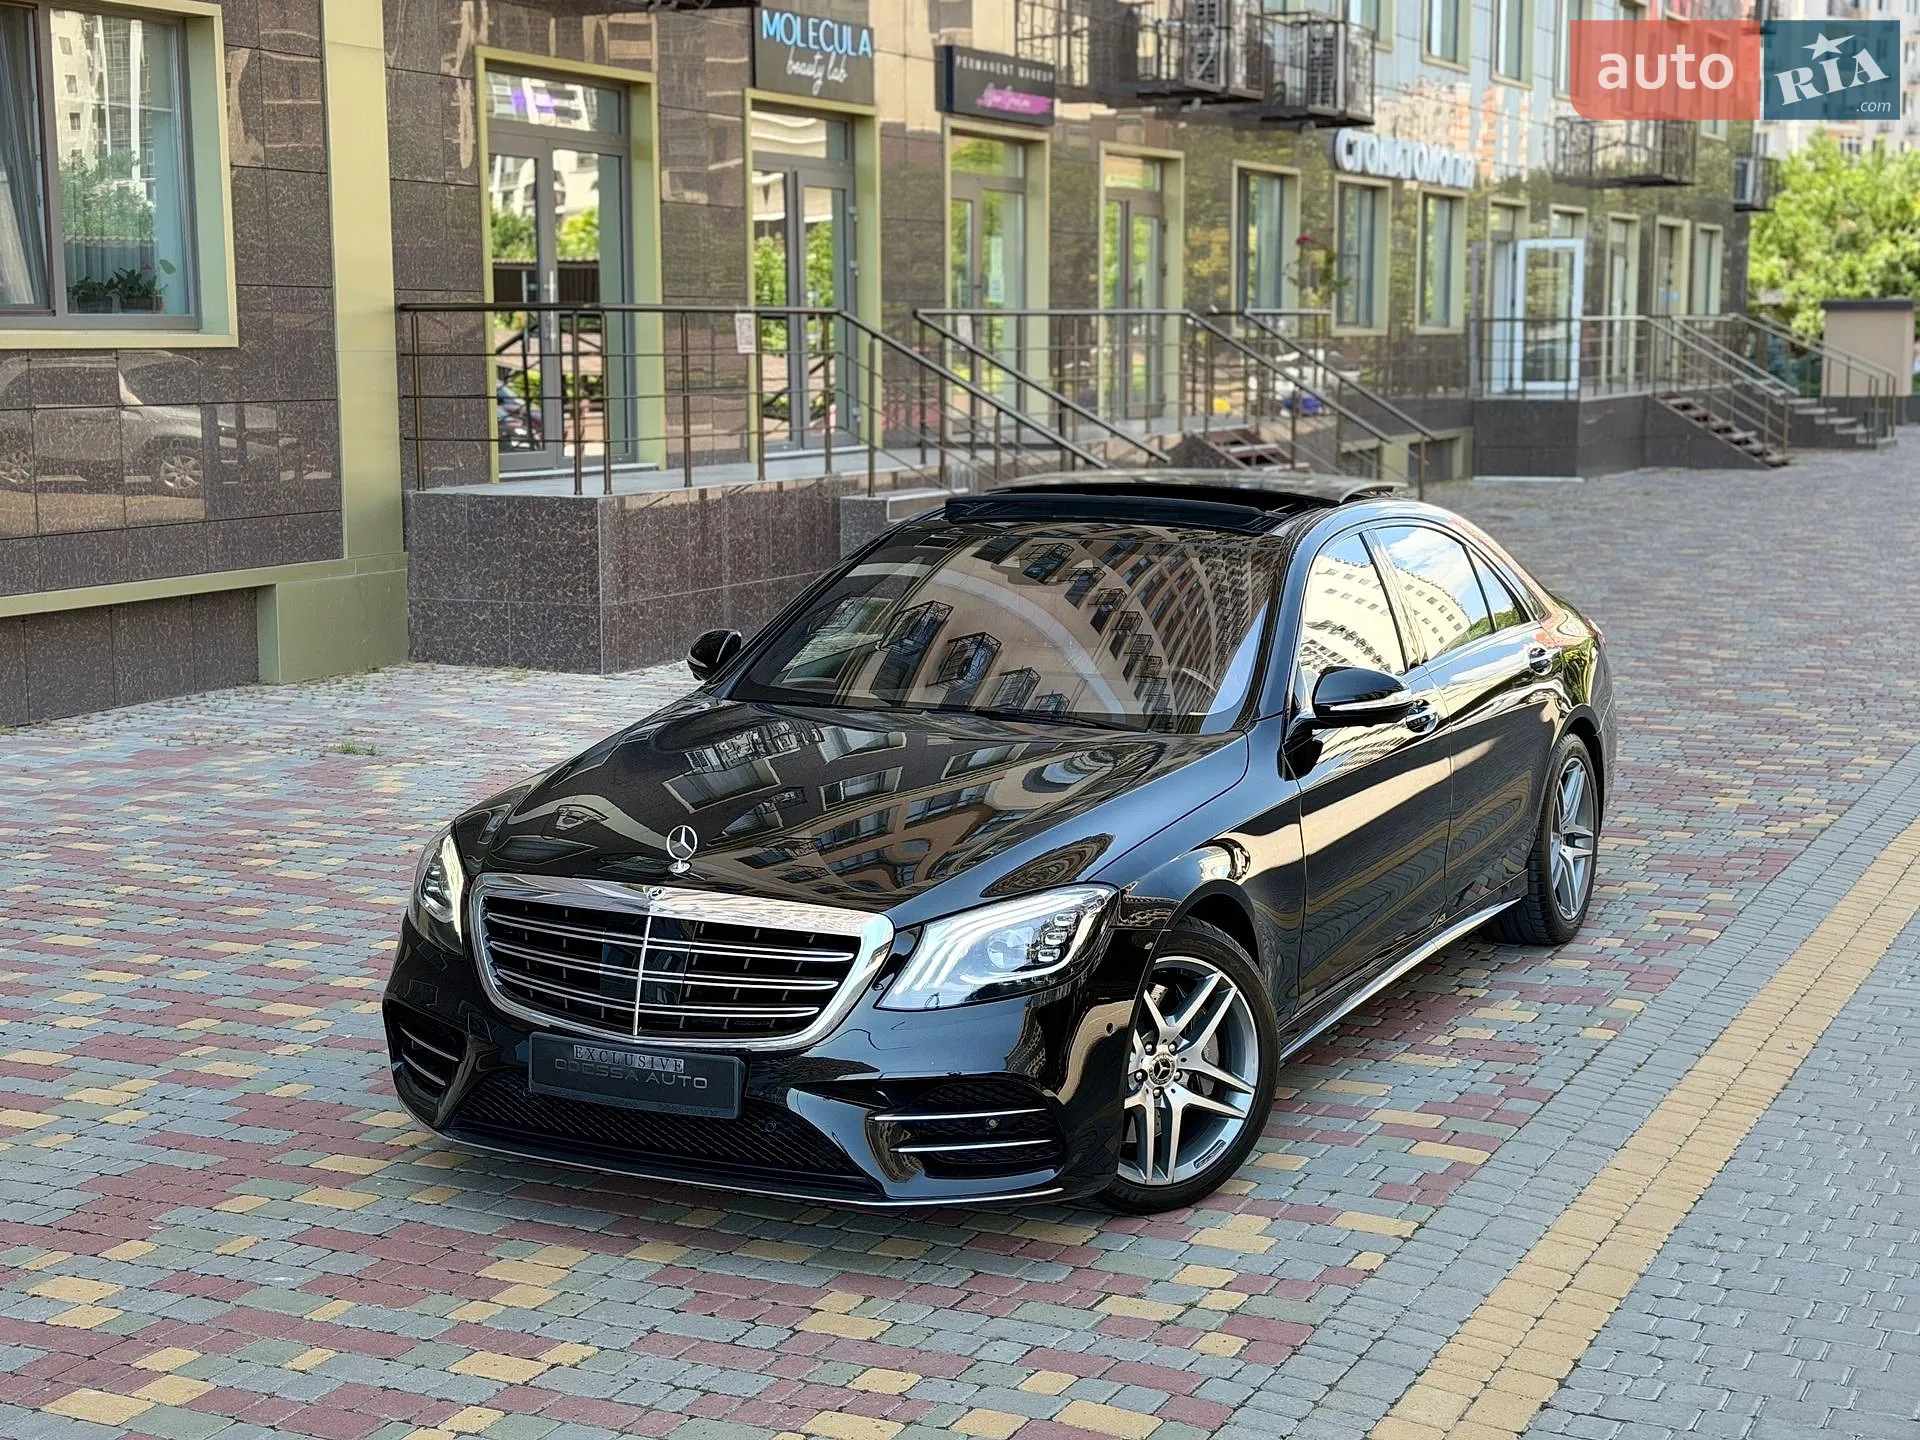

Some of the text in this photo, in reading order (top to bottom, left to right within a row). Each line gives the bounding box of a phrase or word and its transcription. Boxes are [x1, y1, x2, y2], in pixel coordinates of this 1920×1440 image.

[762, 9, 872, 58] MOLECULA
[786, 46, 848, 96] beauty lab
[554, 1058, 708, 1090] ODESSA AUTO
[575, 1046, 684, 1073] EXCLUSIVE
